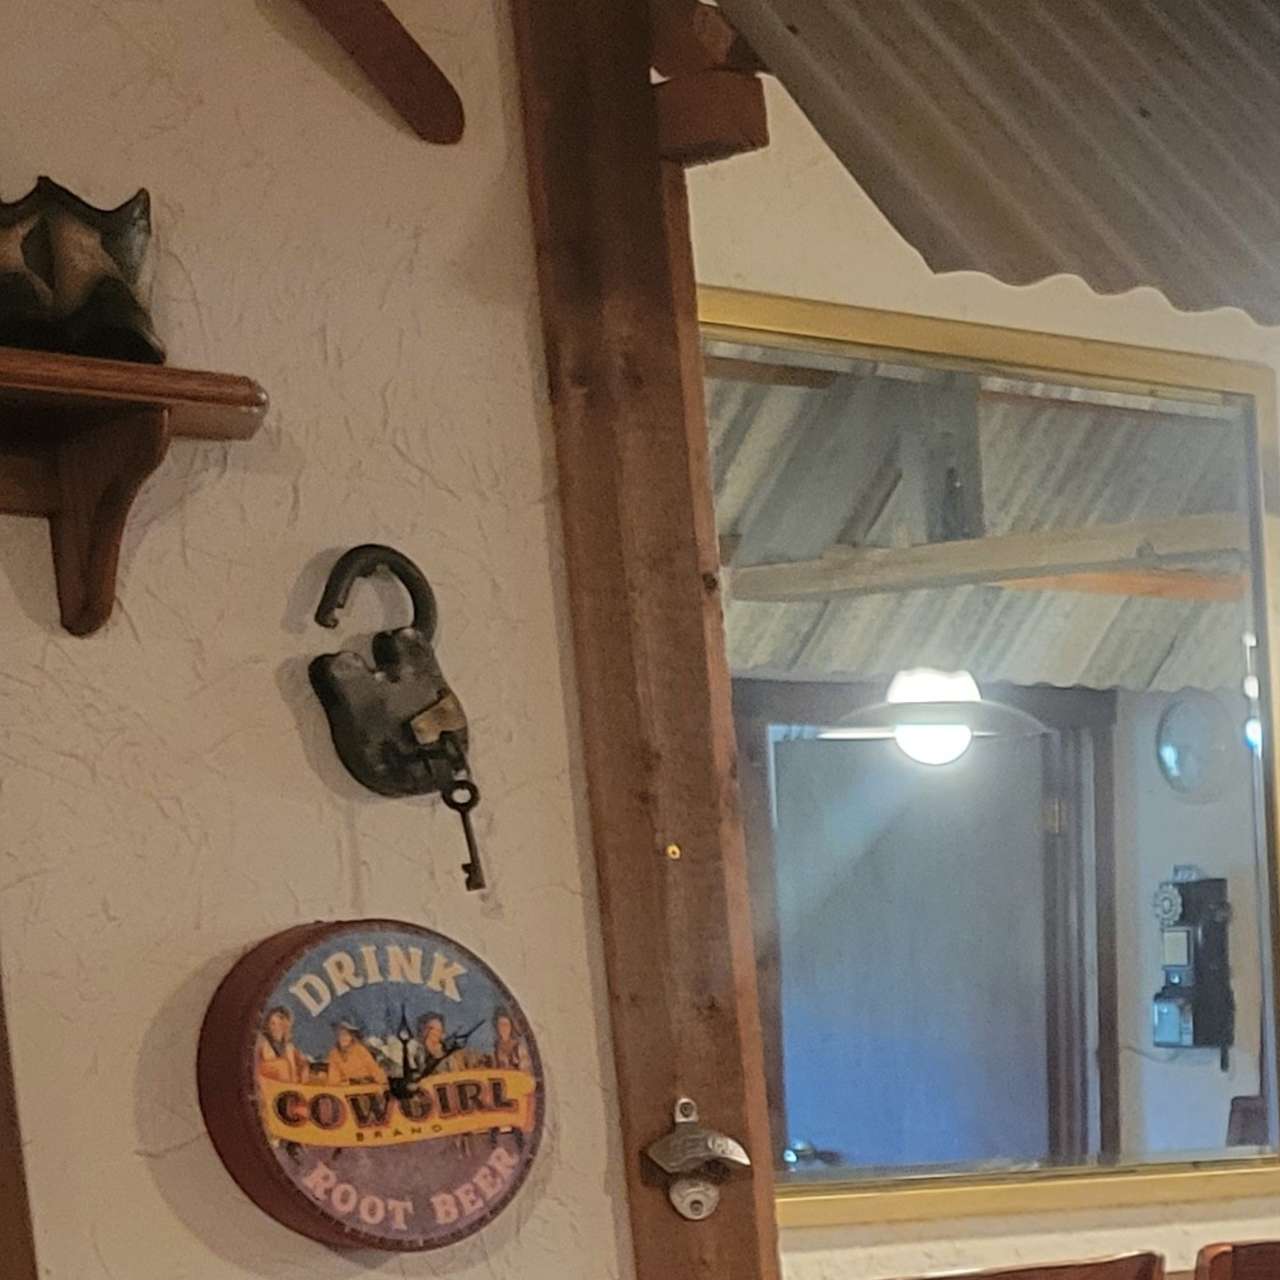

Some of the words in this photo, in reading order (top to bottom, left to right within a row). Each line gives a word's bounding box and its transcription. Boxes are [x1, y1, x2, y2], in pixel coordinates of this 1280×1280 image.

[288, 944, 468, 1017] DRINK
[272, 1077, 520, 1131] COWGIRL
[355, 1124, 444, 1142] BRAND
[302, 1161, 414, 1231] ROOT
[430, 1146, 520, 1225] BEER
